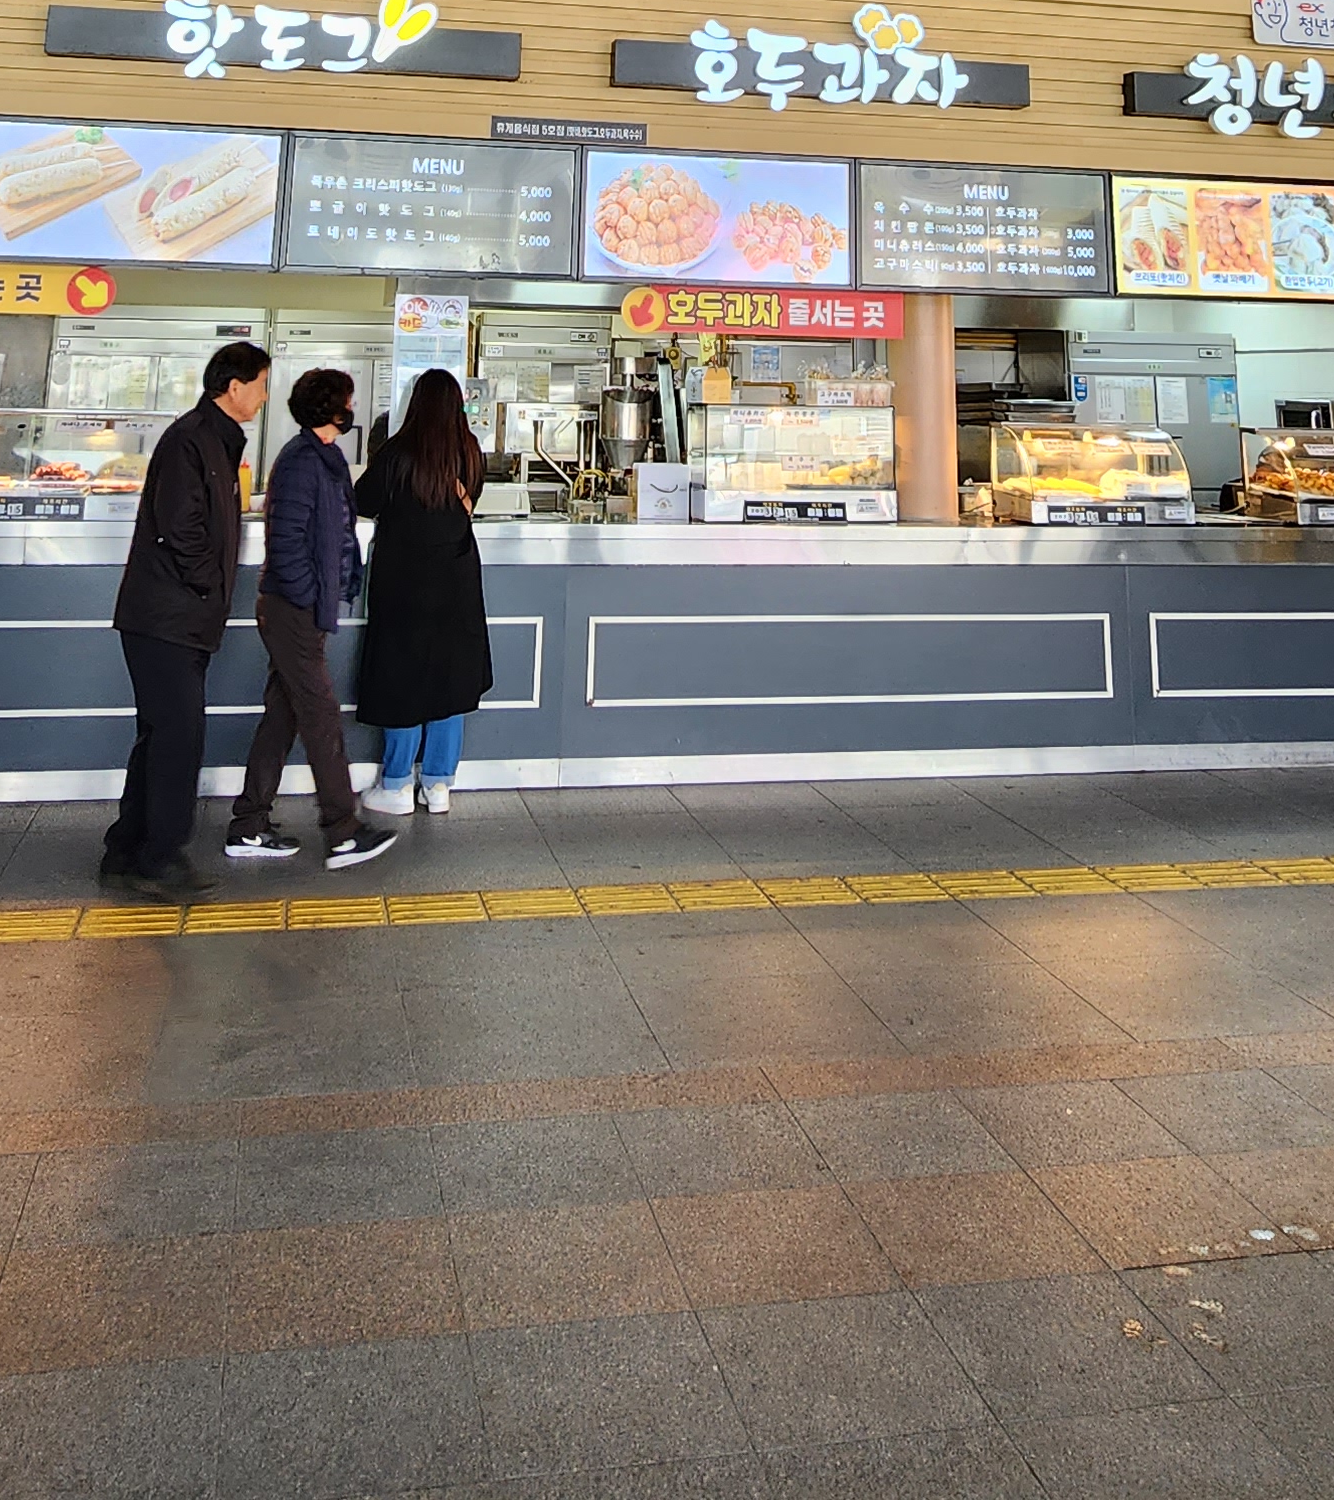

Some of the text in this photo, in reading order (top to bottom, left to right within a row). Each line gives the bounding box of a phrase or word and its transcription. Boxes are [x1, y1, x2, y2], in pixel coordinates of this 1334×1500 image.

[690, 18, 969, 122] 호두과자
[496, 122, 540, 135] 휴게음식점
[412, 158, 465, 175] MENU
[352, 177, 437, 193] 크리스피핫도그
[520, 186, 552, 199] 5,000
[963, 184, 1010, 200] MENU
[519, 210, 552, 223] 4,000
[955, 204, 984, 218] 3,500
[995, 205, 1038, 220] 호두과자
[955, 222, 985, 237] 3,500
[995, 224, 1039, 239] 호두과자
[1066, 227, 1094, 241] 3,000
[518, 234, 551, 247] 5,000
[956, 241, 985, 255] 4,000
[996, 243, 1095, 259] 호두과자 5,000
[957, 260, 986, 274] 3,500
[996, 261, 1096, 278] 호두과자 10,000
[15, 273, 42, 302] 곳
[666, 289, 885, 329] 호두과자 줄서는 곳
